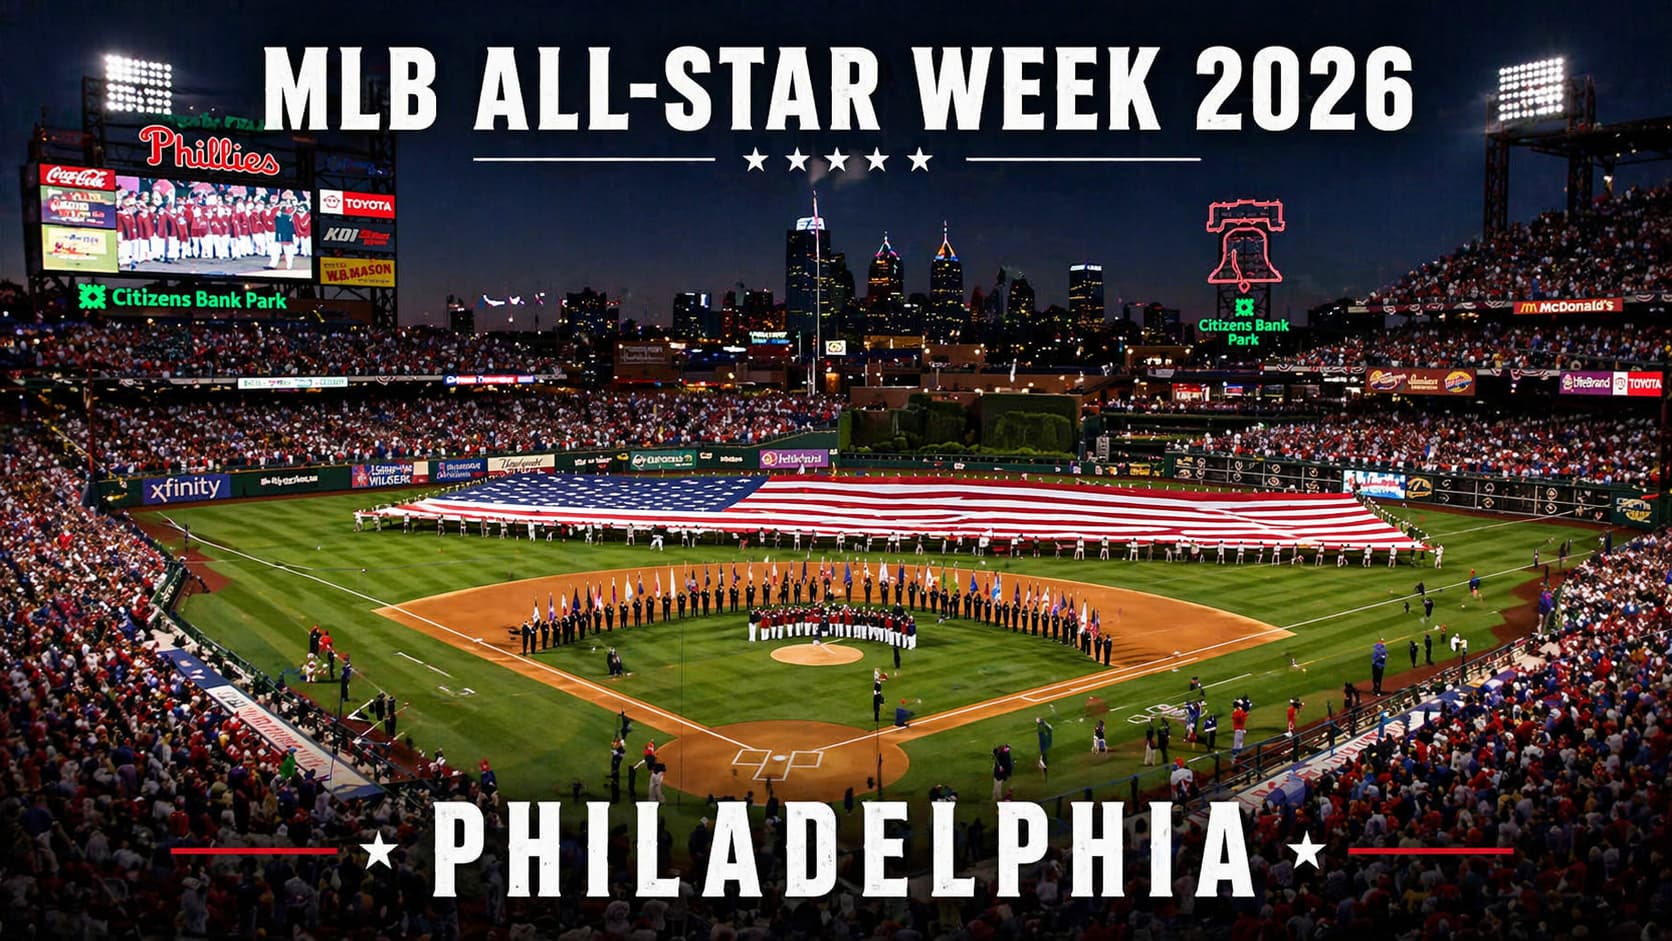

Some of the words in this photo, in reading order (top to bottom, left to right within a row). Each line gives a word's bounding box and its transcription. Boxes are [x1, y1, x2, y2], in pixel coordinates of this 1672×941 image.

[139, 124, 280, 176] Phillies
[345, 198, 392, 212] TOYOTA
[112, 288, 191, 307] Citizens
[195, 291, 242, 308] Bank
[246, 292, 288, 309] Park
[1540, 300, 1614, 313] McDonald's
[1199, 319, 1252, 332] Citizens
[1255, 319, 1290, 332] Bank
[1228, 333, 1260, 346] Park
[1629, 378, 1662, 389] TOYOTA
[151, 477, 222, 503] xfinity
